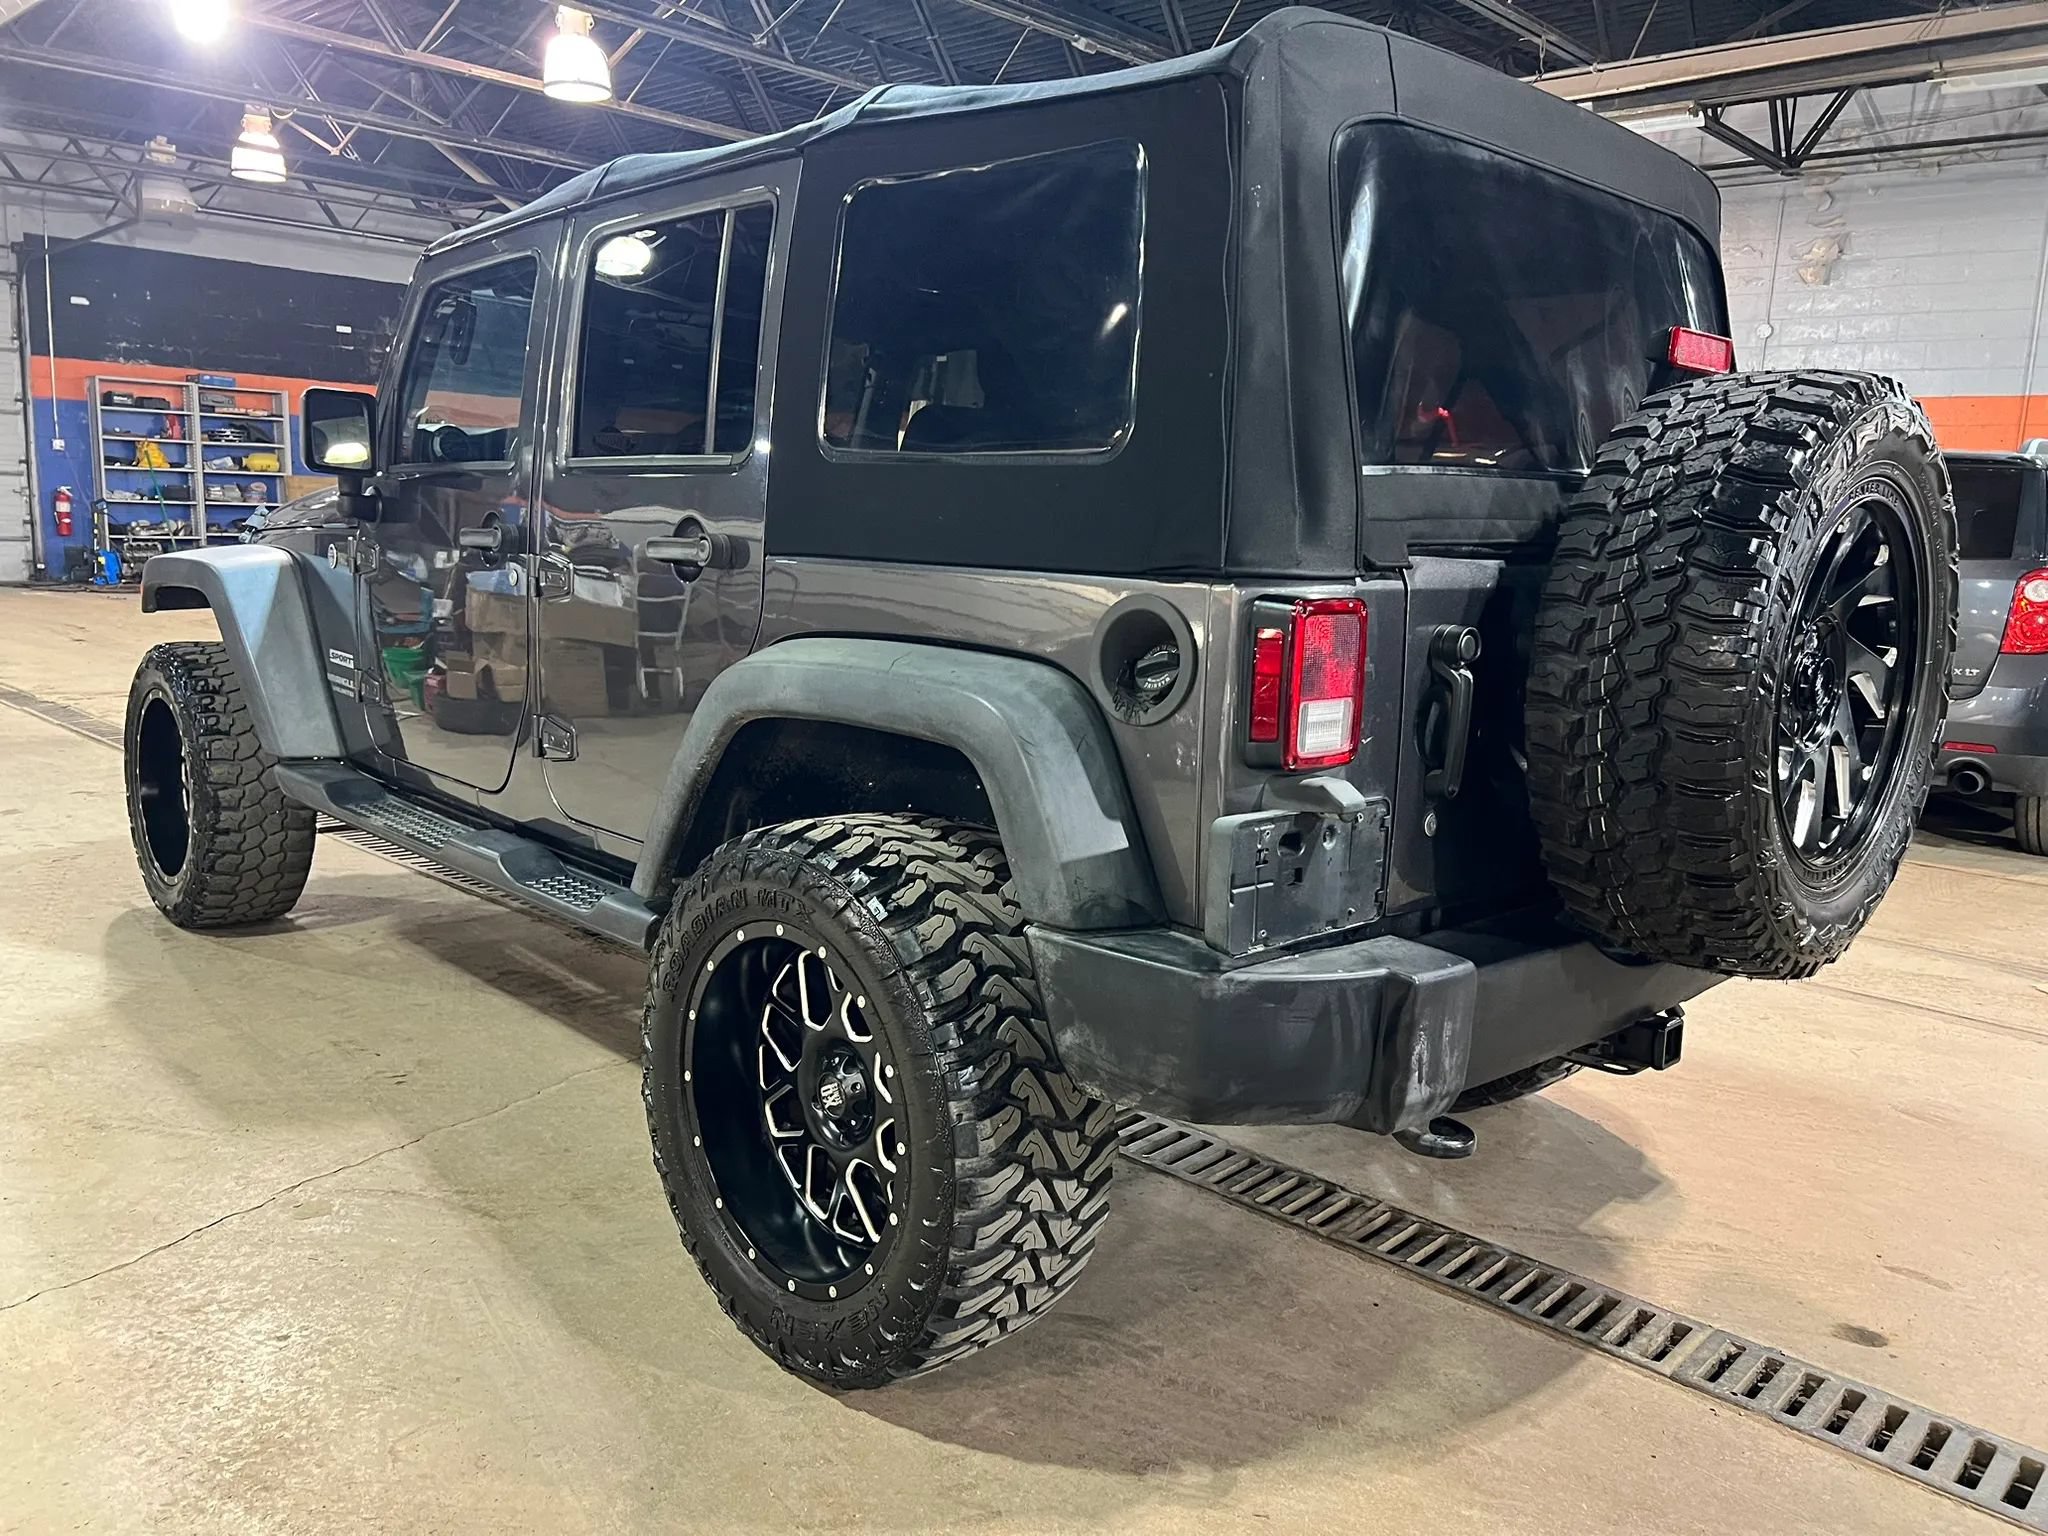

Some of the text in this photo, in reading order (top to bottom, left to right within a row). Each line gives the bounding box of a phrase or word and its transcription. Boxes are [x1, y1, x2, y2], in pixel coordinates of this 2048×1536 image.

[330, 651, 354, 666] SPORT
[756, 887, 816, 925] MTX
[769, 1286, 889, 1342] NEXEN
